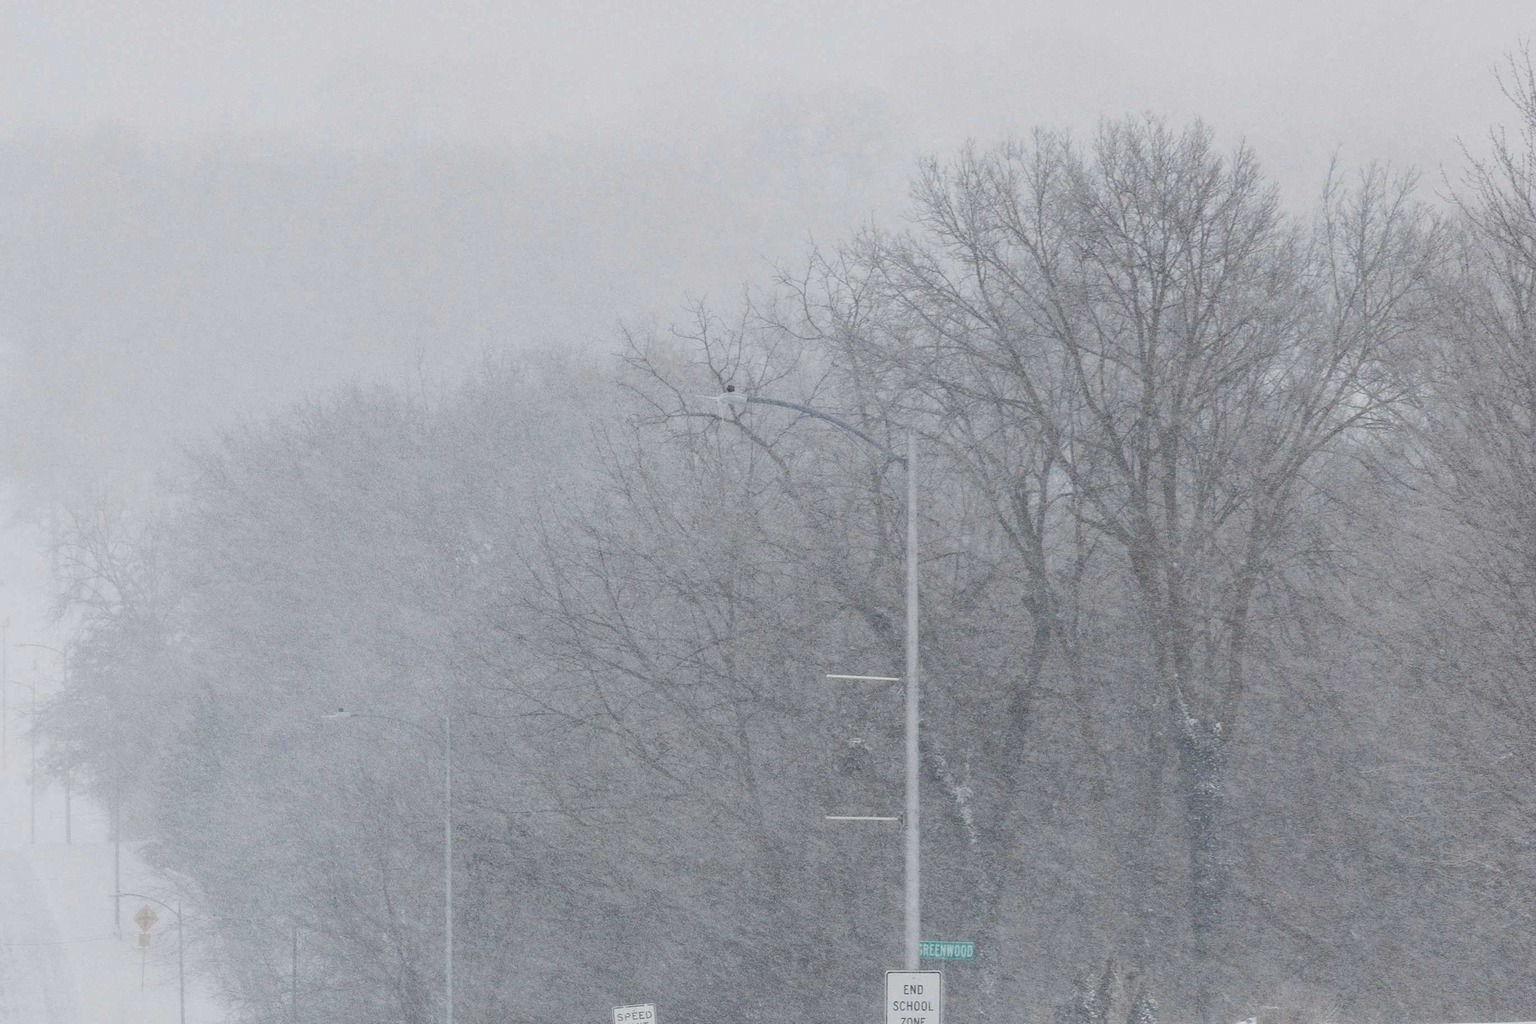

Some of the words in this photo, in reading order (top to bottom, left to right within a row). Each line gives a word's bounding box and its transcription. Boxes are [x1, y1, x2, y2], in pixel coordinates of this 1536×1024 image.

[903, 984, 924, 995] END
[893, 1000, 934, 1012] SCHOOL
[617, 1010, 653, 1022] SPEED
